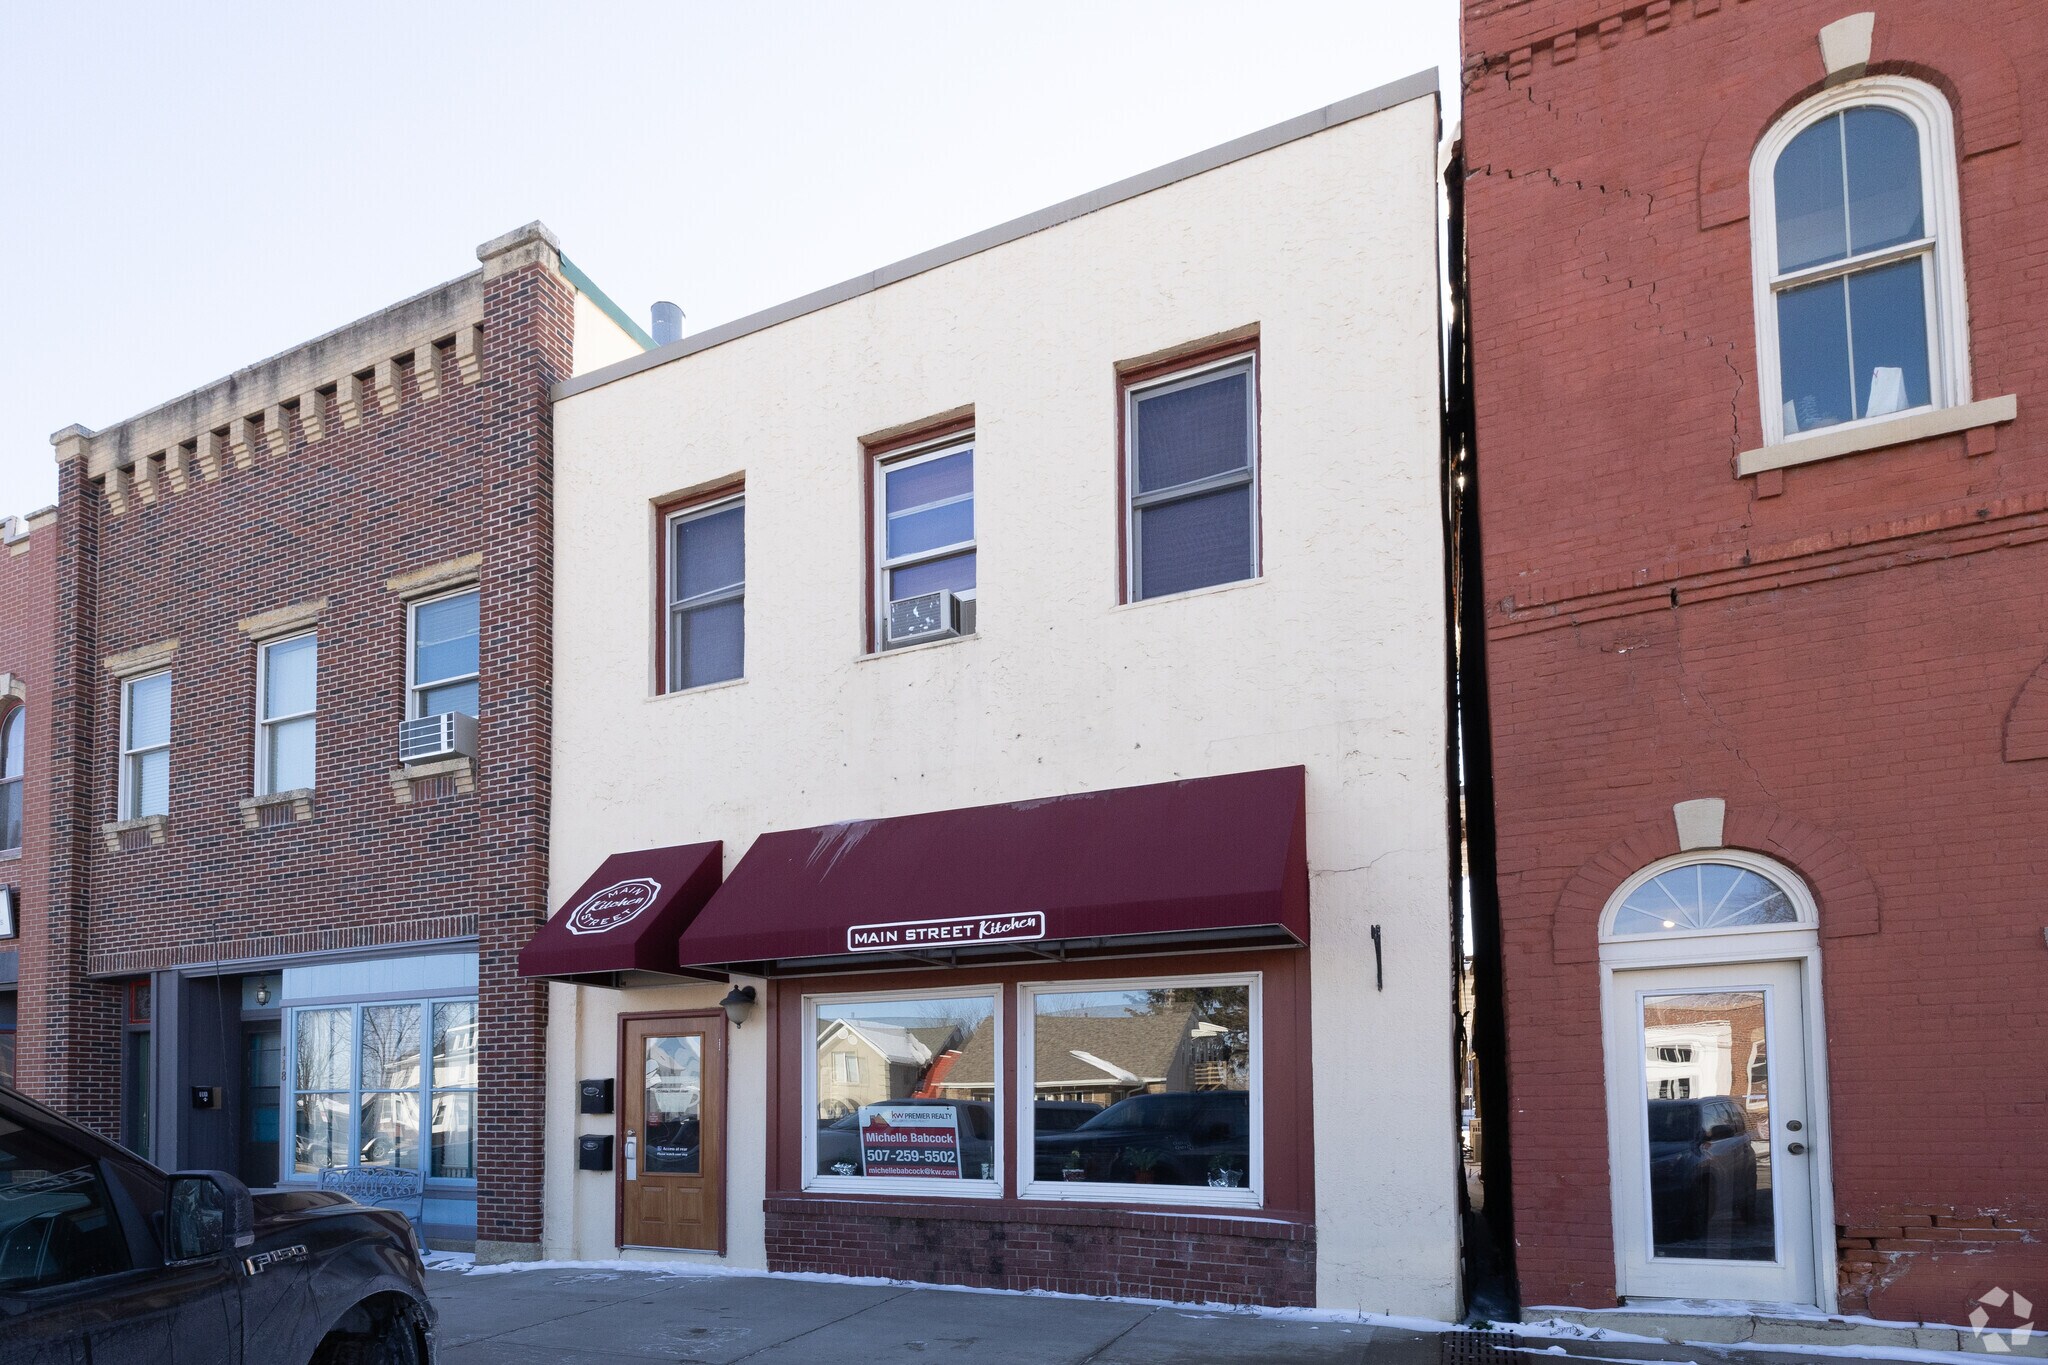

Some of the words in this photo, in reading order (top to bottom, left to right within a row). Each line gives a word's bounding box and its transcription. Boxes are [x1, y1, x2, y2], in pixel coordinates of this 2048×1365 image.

[608, 886, 644, 898] MAIN
[585, 897, 644, 914] Kitchen
[581, 908, 631, 926] STREET
[855, 930, 898, 945] MAIN
[905, 924, 975, 941] STREET
[979, 917, 1036, 939] Kitchen
[904, 1112, 931, 1120] PREMIER
[865, 1132, 908, 1143] Michelle
[910, 1133, 954, 1144] Babcock
[867, 1149, 956, 1163] 507-259-5502
[868, 1167, 957, 1176] michellebabcock@kw.com
